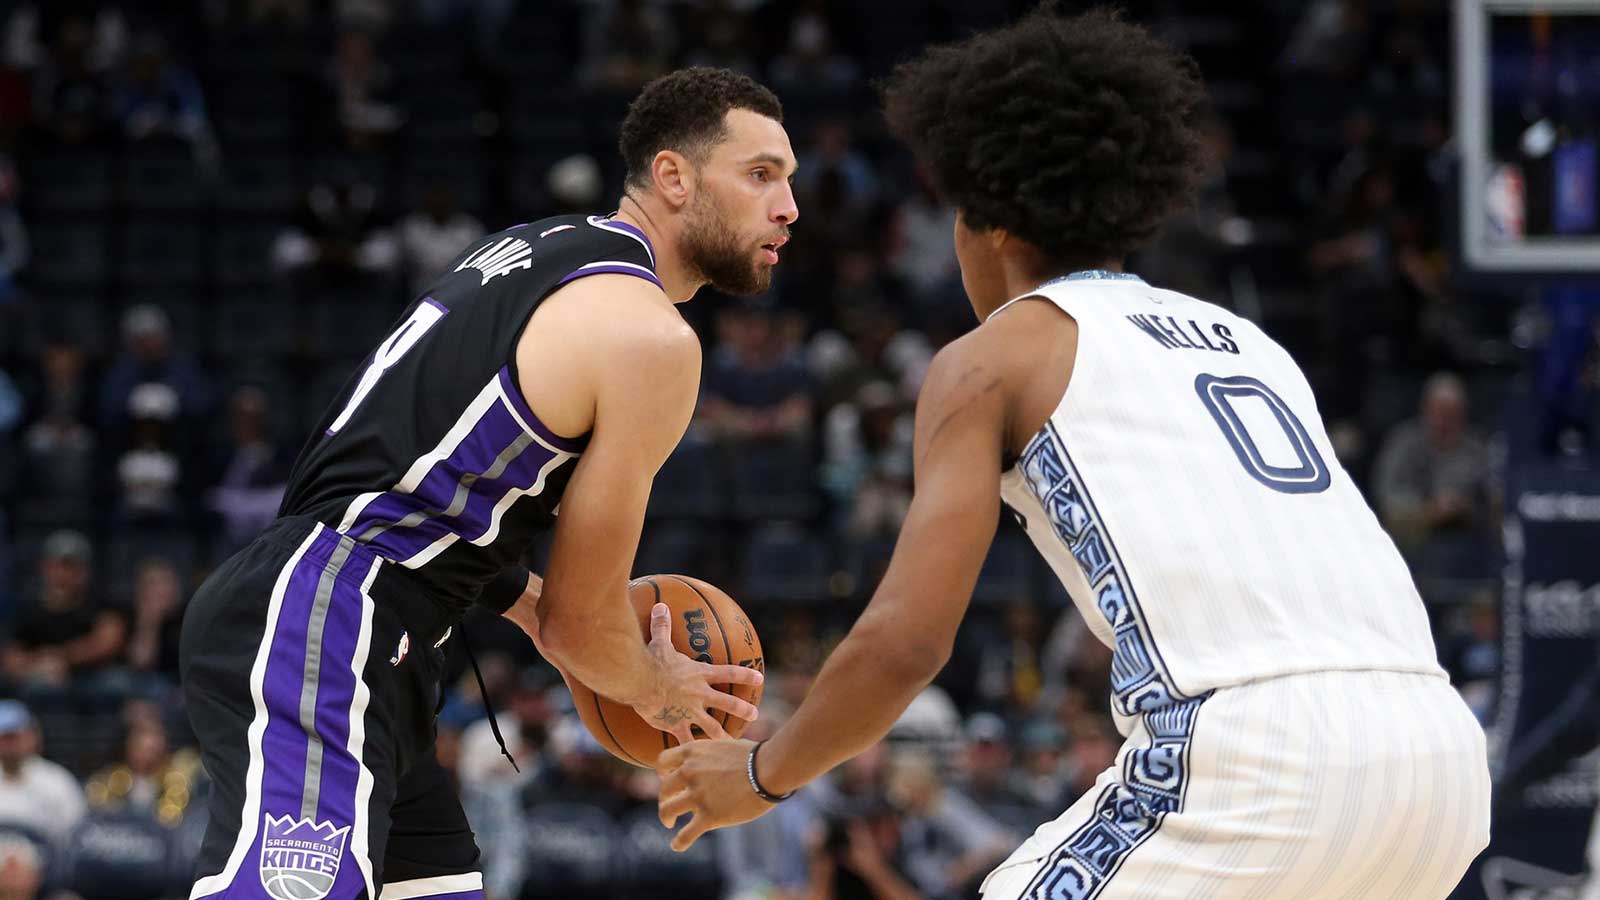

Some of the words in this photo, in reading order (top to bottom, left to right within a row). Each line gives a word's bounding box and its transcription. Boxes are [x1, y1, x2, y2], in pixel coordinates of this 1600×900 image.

[1126, 314, 1240, 355] WELLS
[1194, 373, 1331, 494] 0
[262, 849, 338, 878] KINGS
[267, 838, 339, 856] SACRAMENTO
